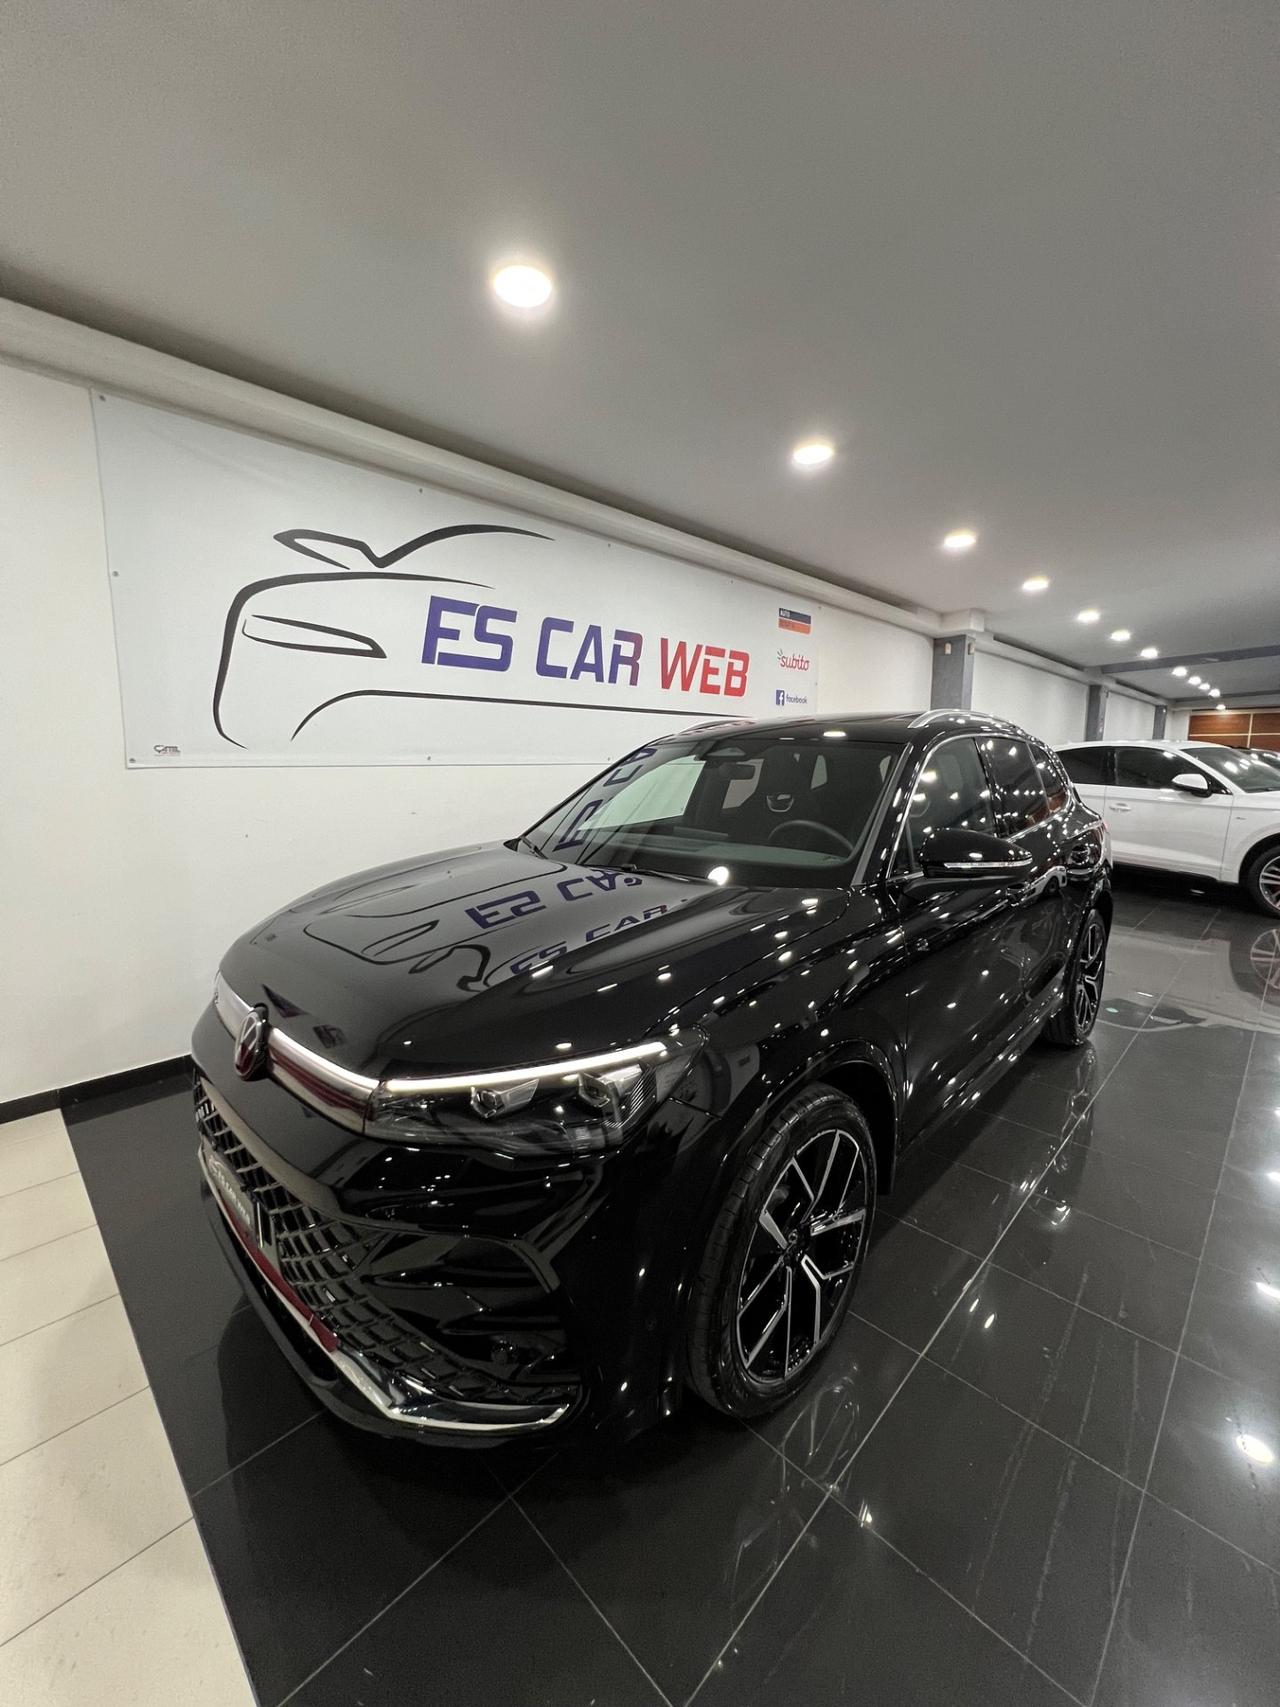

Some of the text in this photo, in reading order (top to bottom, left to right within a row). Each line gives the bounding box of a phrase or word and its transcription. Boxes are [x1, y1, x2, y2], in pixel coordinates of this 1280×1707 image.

[421, 595, 751, 697] ES CAR WEB
[780, 654, 810, 671] subito
[786, 694, 808, 704] facebook
